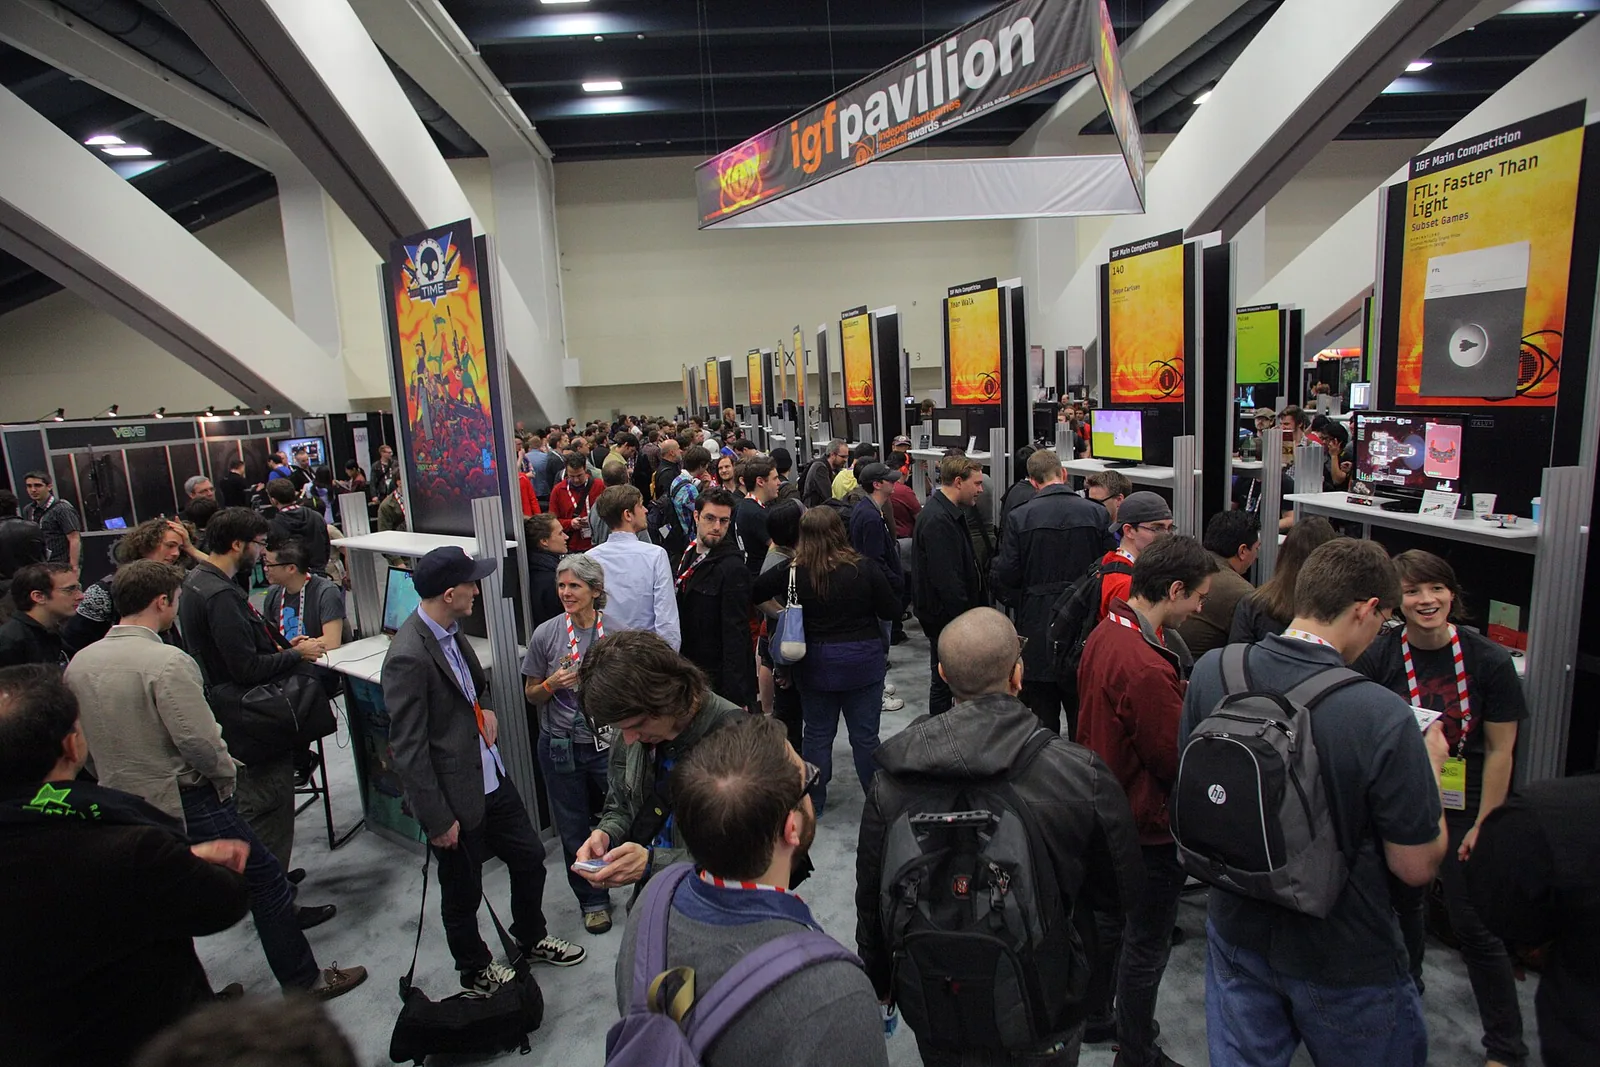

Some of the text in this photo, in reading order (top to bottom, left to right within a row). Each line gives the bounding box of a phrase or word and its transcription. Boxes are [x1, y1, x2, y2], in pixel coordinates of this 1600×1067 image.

[1415, 130, 1521, 172] IGF Main Competition
[1414, 155, 1538, 201] FTL: Faster Than
[1413, 196, 1448, 218] Light
[1411, 212, 1469, 232] Subset Games
[1111, 240, 1159, 258] IGF Main Competition
[1112, 265, 1124, 275] 140
[421, 282, 444, 297] TIME
[774, 350, 811, 367] EXT
[1210, 784, 1225, 804] hp
